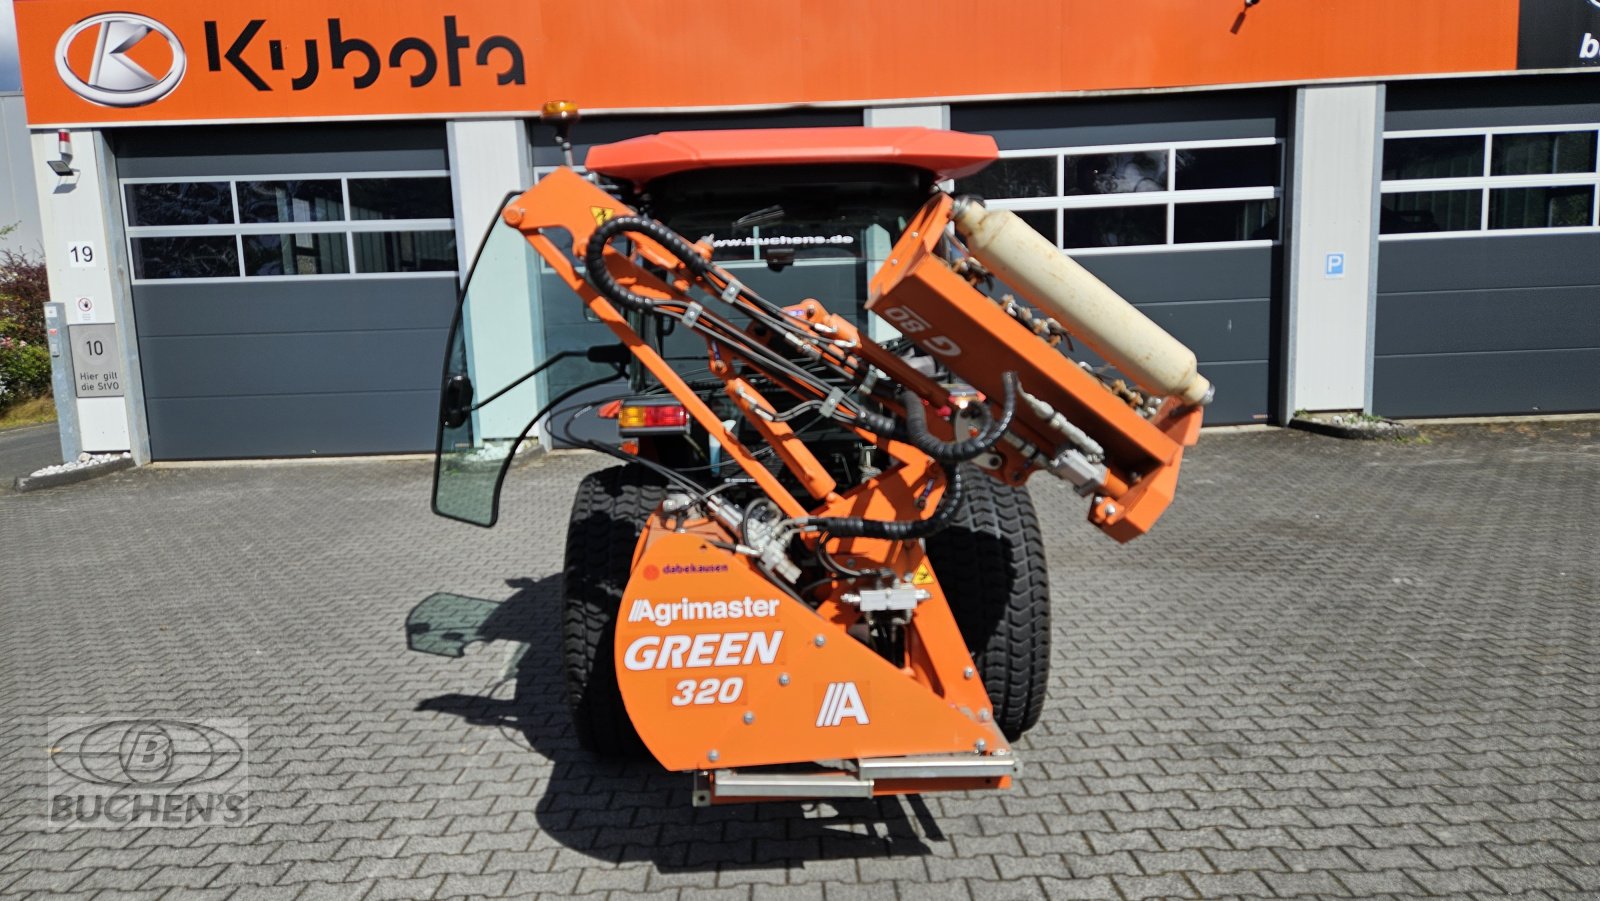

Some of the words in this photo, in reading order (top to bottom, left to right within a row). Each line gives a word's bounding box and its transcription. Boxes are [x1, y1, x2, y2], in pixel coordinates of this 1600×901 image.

[204, 15, 526, 91] Kubota
[1579, 32, 1600, 58] b
[713, 235, 854, 248] ww.buchens.de
[70, 246, 93, 262] 19
[1328, 255, 1341, 272] P
[86, 340, 104, 356] 10
[922, 335, 962, 357] G
[80, 372, 98, 380] Hier
[103, 372, 118, 380] gilt
[81, 383, 95, 391] die
[97, 381, 119, 391] StVO
[628, 596, 780, 626] Agrimaster
[624, 630, 784, 671] GREEN
[671, 677, 744, 706] 320
